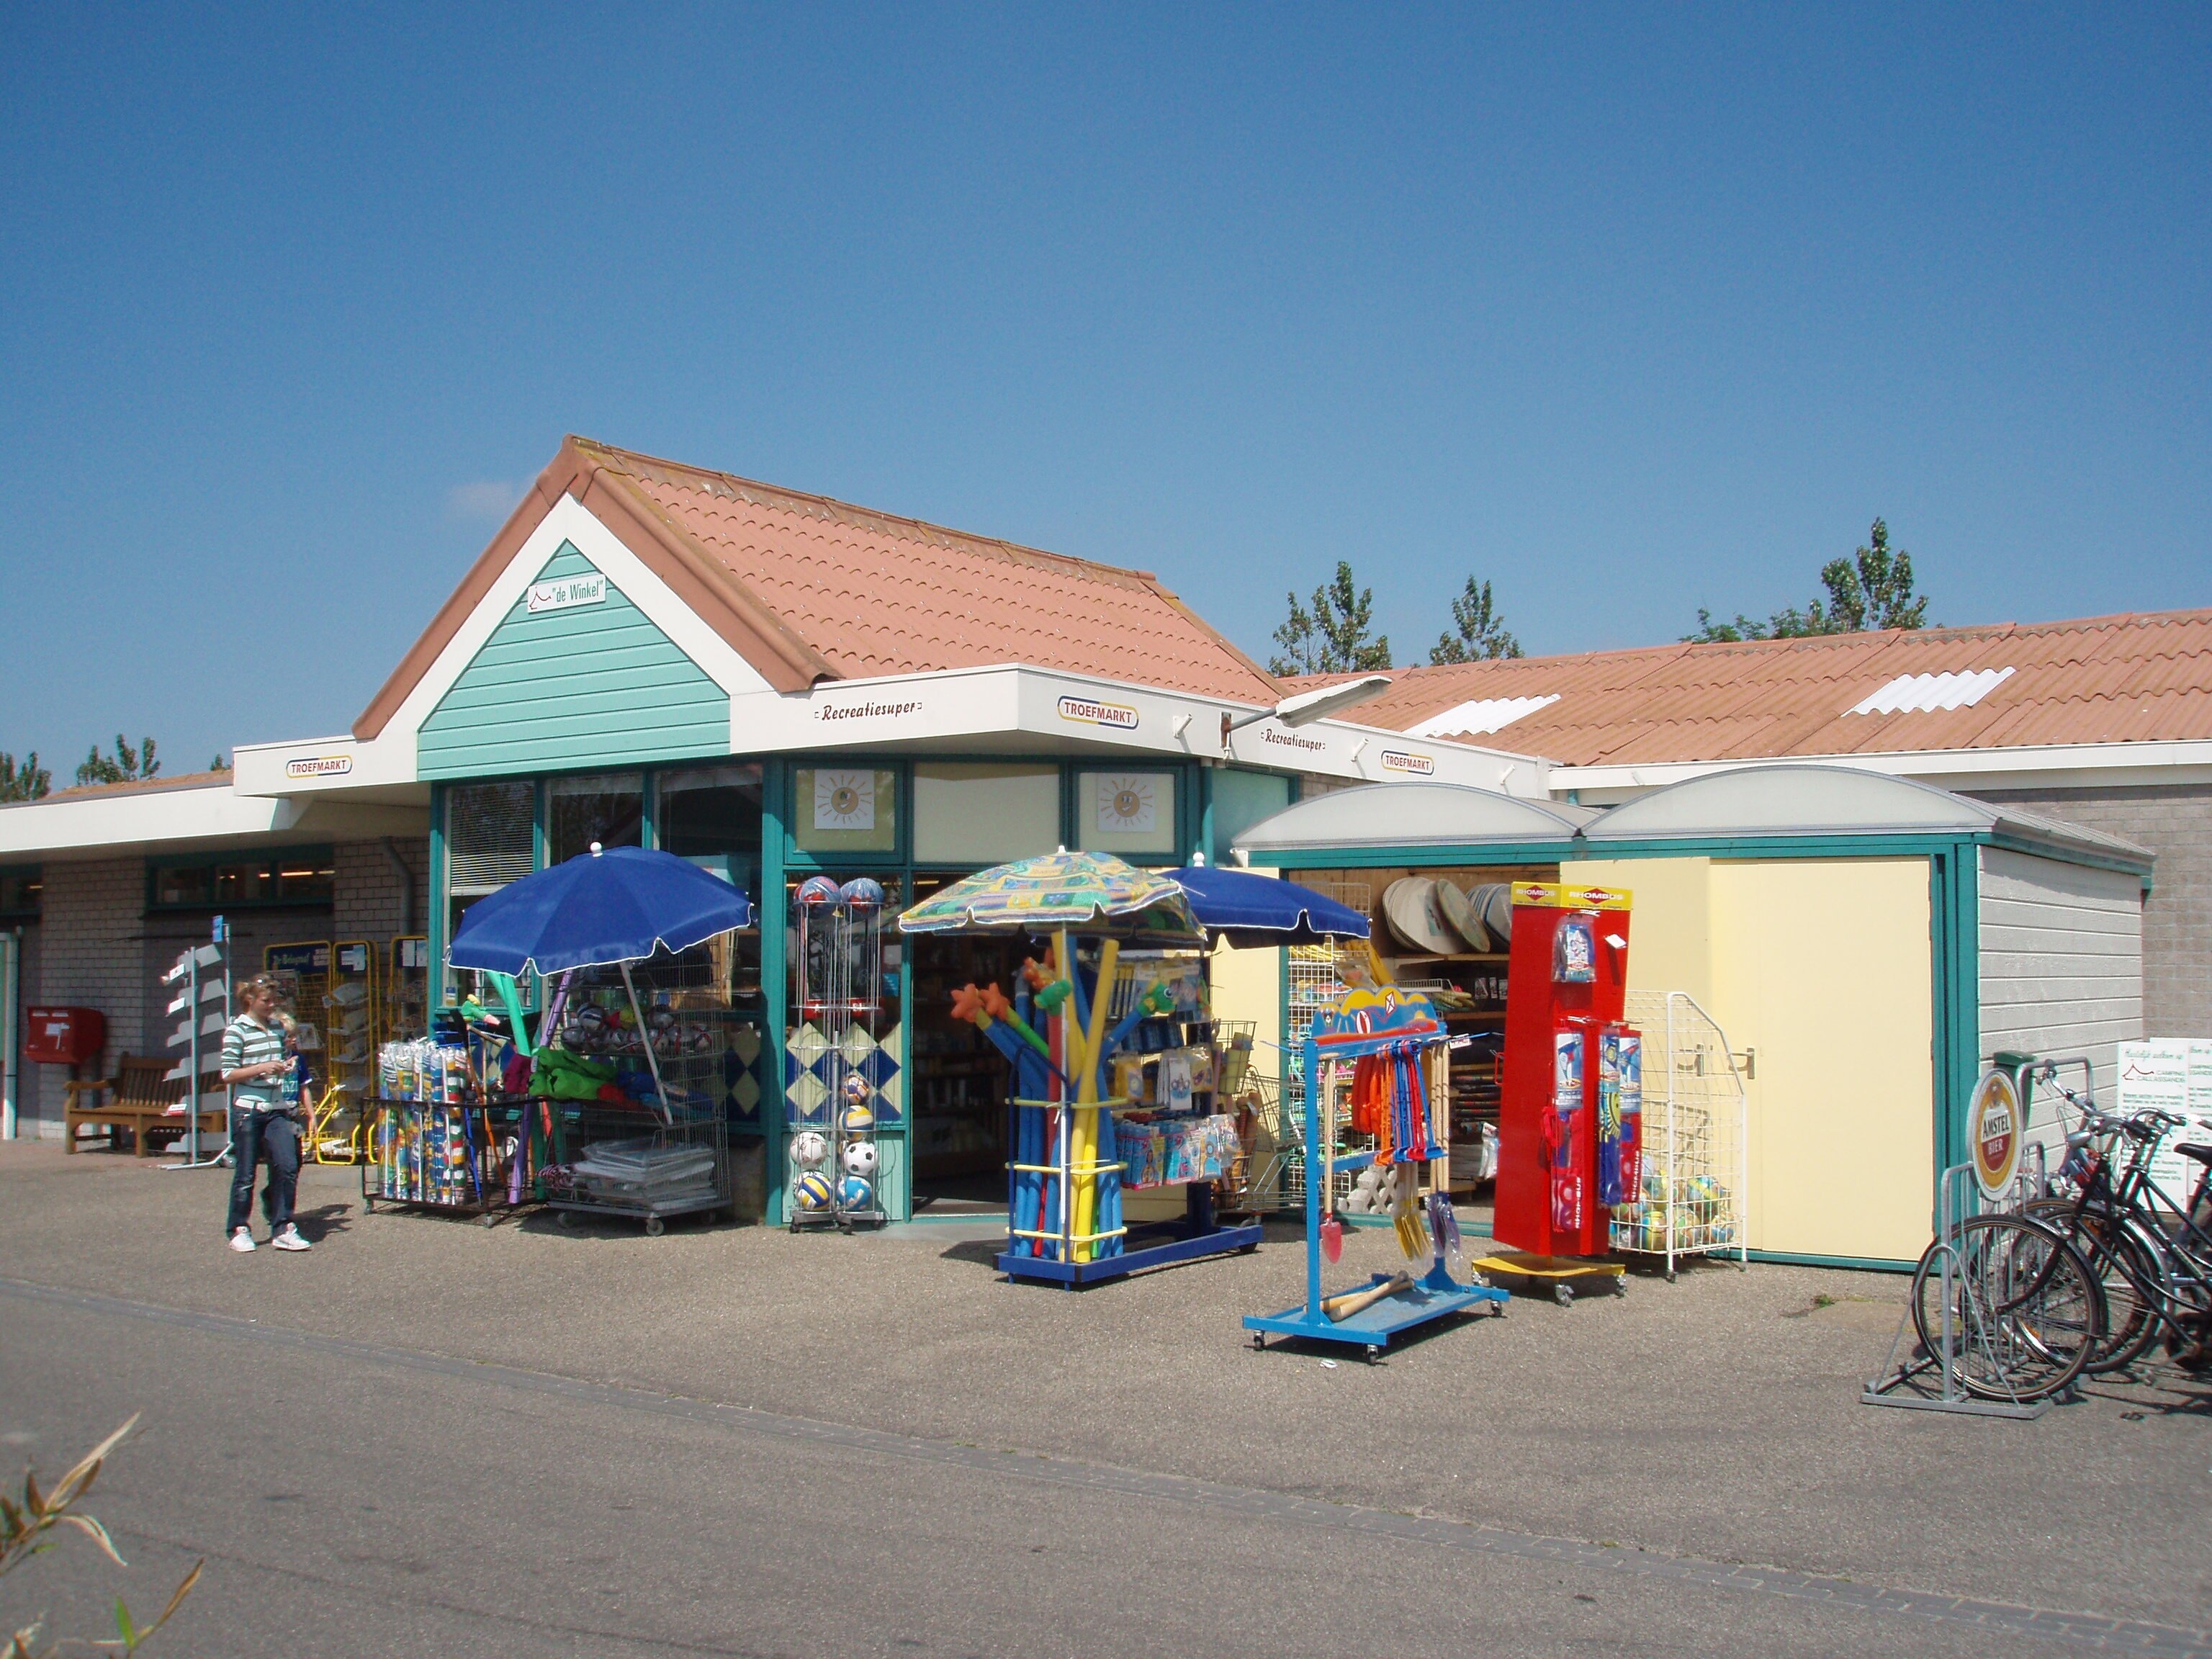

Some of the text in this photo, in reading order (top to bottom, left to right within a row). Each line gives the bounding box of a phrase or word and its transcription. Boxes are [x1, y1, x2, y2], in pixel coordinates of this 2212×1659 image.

[822, 702, 915, 721] Recreatiesuper
[1064, 702, 1132, 723] TROEFMARKT
[1265, 728, 1321, 752] Recreatiesuper
[292, 760, 346, 773] TROEFMARKT
[1385, 755, 1430, 770] TROEFMARKT
[1516, 889, 1555, 897] RHOMBUS
[1569, 891, 1624, 901] RHOMBUS
[1982, 1114, 2009, 1138] AMSTEL
[1988, 1138, 2003, 1155] BIER
